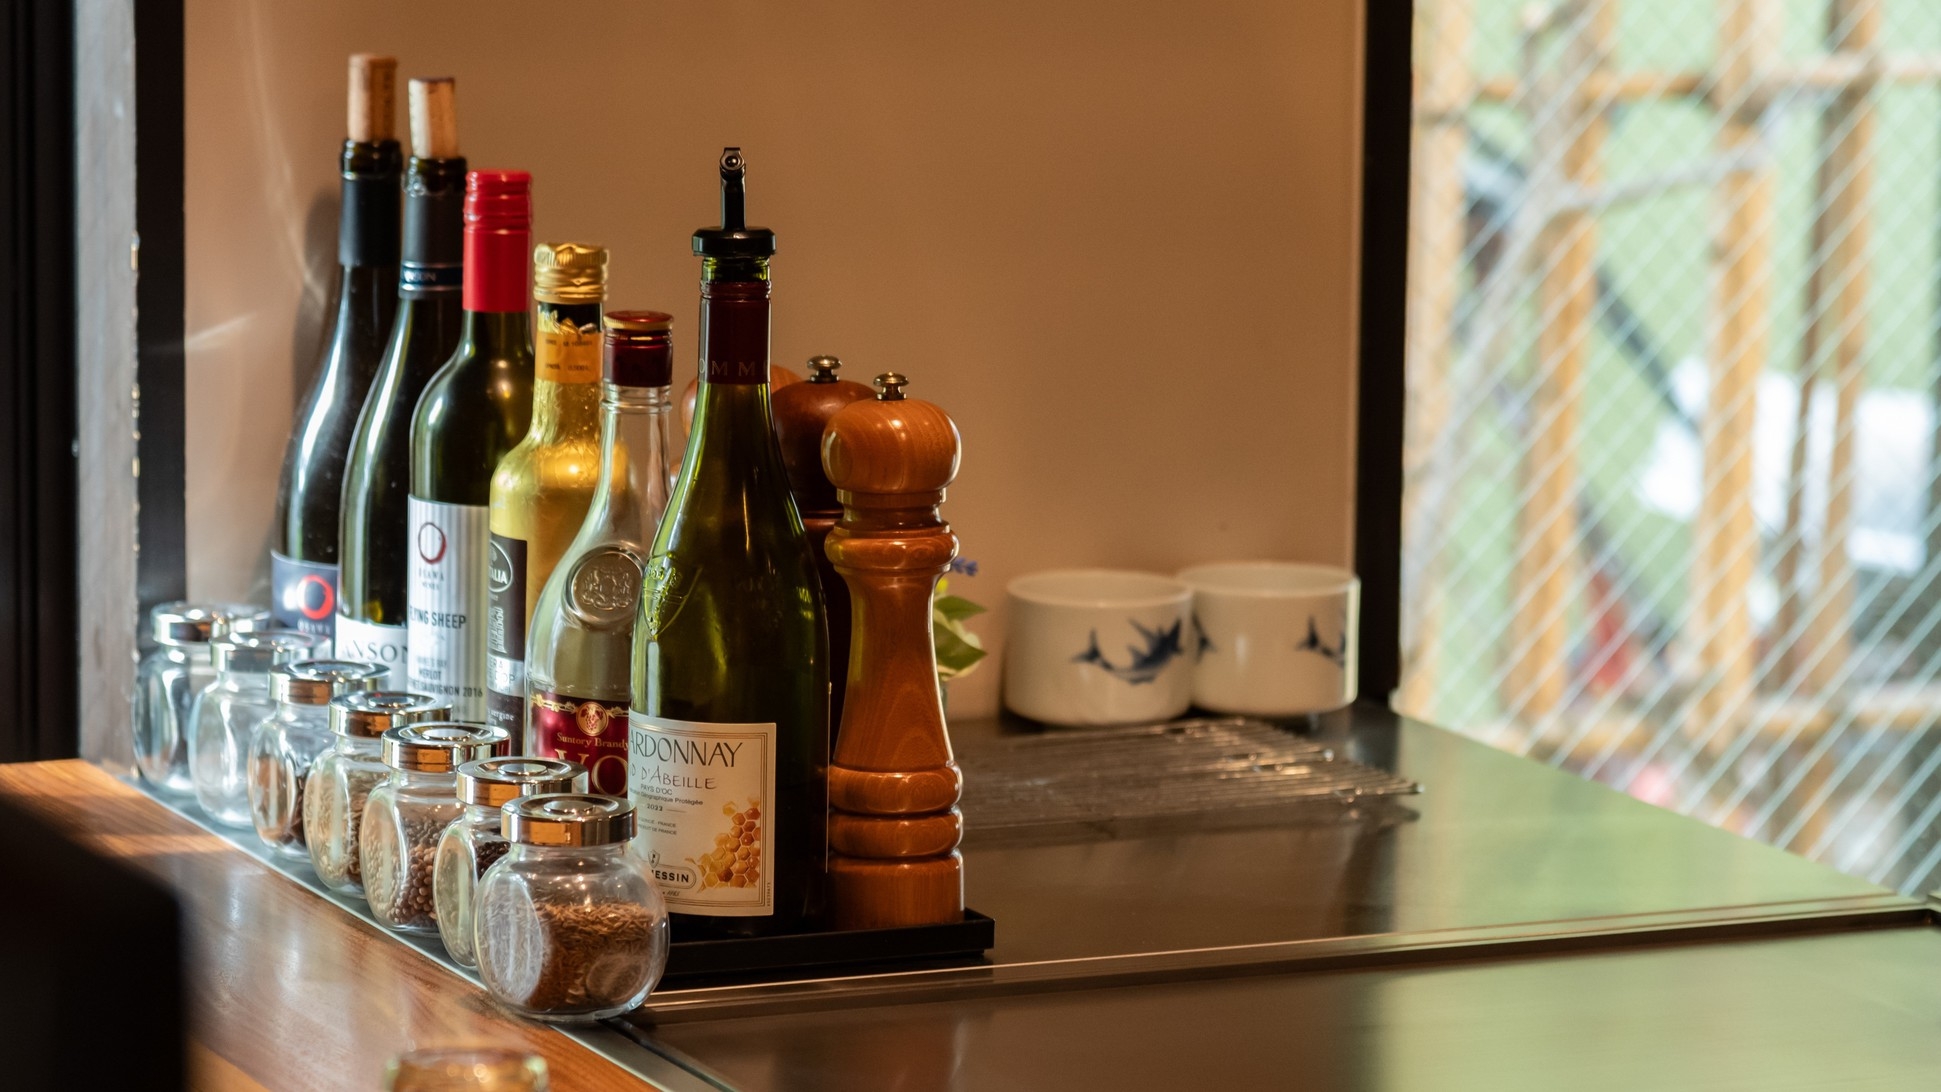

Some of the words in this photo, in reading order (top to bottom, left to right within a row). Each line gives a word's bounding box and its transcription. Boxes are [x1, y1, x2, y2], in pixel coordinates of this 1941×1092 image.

[432, 612, 467, 629] SHEEP
[463, 686, 483, 698] 2016
[556, 731, 592, 748] Suntory
[594, 736, 629, 751] Brandy
[641, 765, 717, 790] D'ABEILLE
[641, 783, 655, 792] PAYS
[656, 787, 673, 796] D'OC
[657, 820, 676, 829] FRANCE
[658, 828, 678, 836] FRANCE
[652, 869, 690, 883] ESSIN
